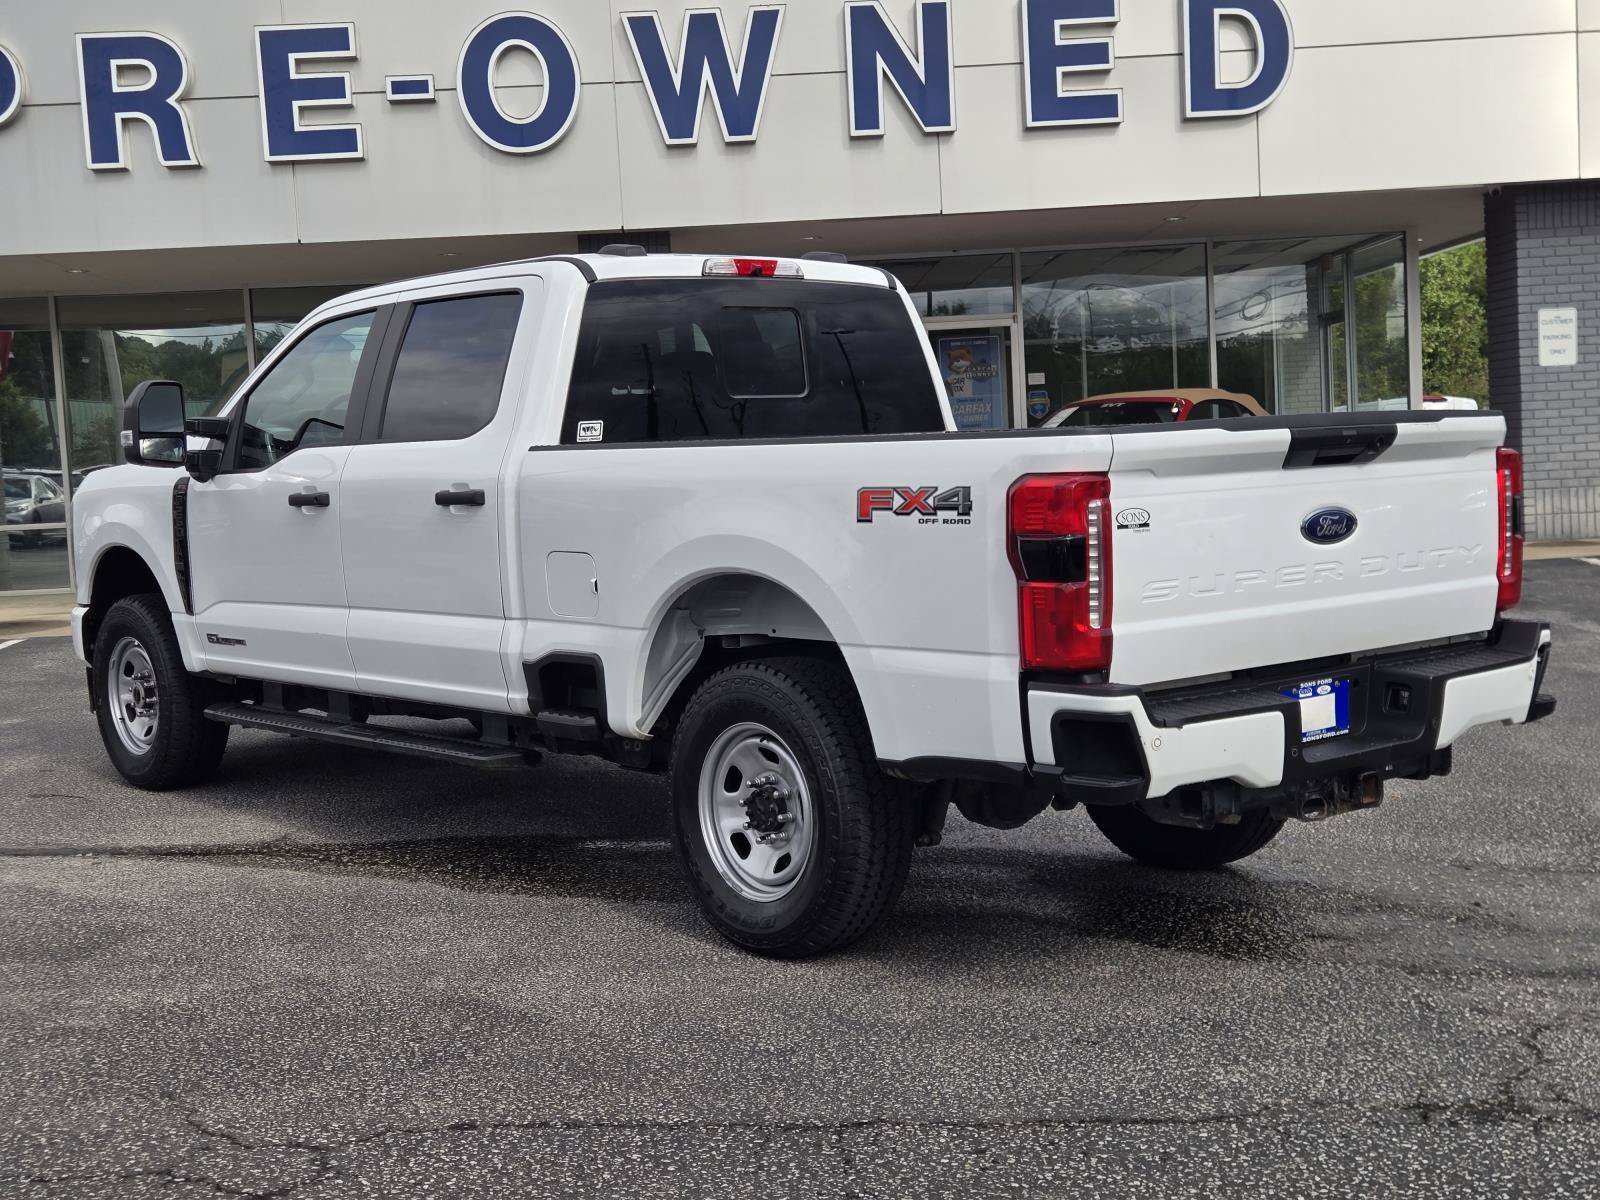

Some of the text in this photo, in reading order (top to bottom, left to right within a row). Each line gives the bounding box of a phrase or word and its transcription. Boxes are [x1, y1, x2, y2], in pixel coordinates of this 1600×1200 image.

[0, 0, 1295, 171] RE-OWNED
[857, 486, 972, 523] FX4
[1121, 512, 1146, 523] SONS
[1316, 515, 1347, 537] Ford
[1141, 543, 1484, 604] SUPER DUTY
